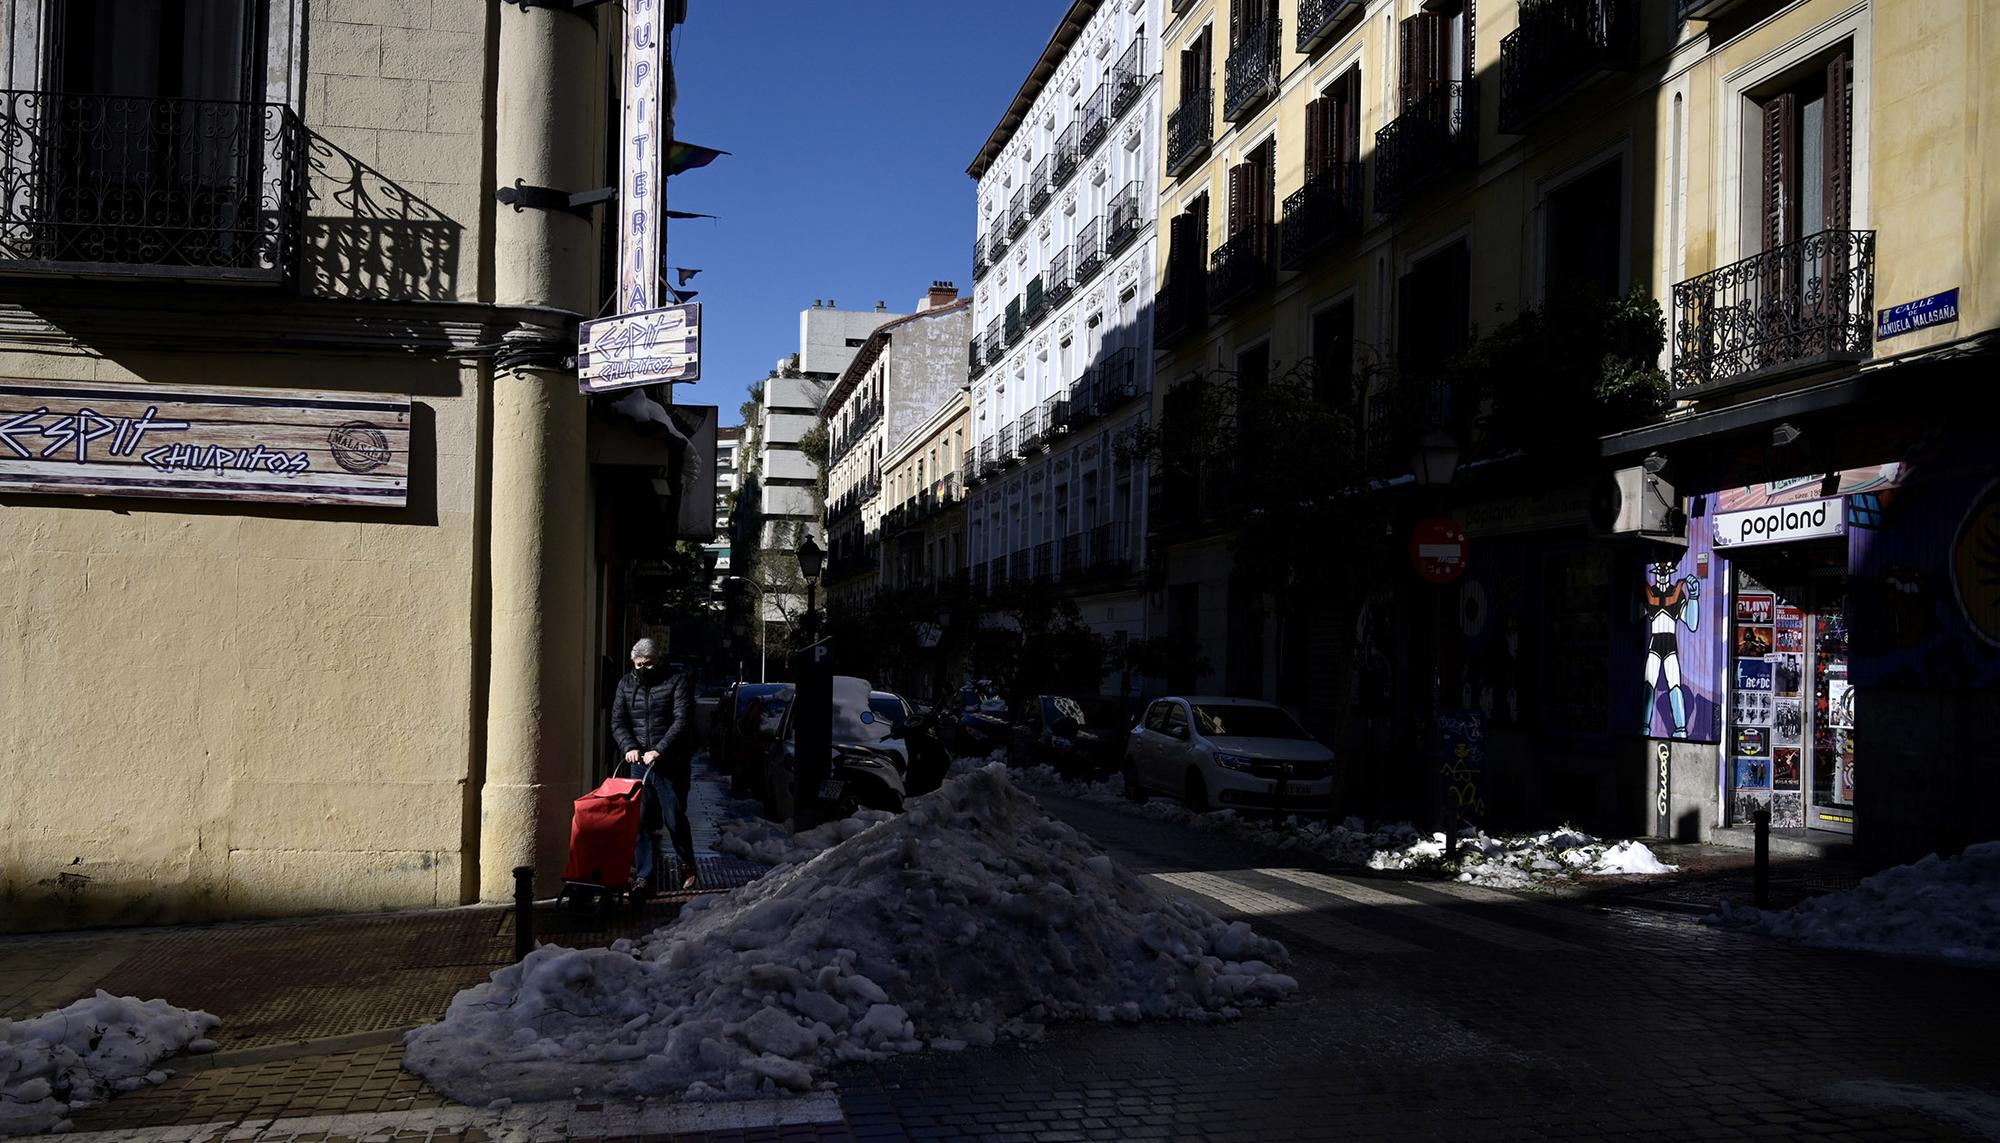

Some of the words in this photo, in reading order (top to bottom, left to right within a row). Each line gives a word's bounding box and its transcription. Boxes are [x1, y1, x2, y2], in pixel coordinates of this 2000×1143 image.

[1895, 297, 1935, 314] CALLE
[1908, 309, 1918, 317] DE
[1878, 318, 1911, 337] MANUELA
[1913, 305, 1956, 327] MALASAÑA
[594, 314, 684, 361] ESPIT
[599, 356, 673, 383] CHUPITOS
[0, 405, 190, 463] ESPIT
[142, 443, 311, 479] CHUPITOS
[1741, 502, 1827, 542] popland
[1776, 620, 1803, 629] STONES
[814, 646, 828, 662] P
[1746, 677, 1770, 689] AC/DC
